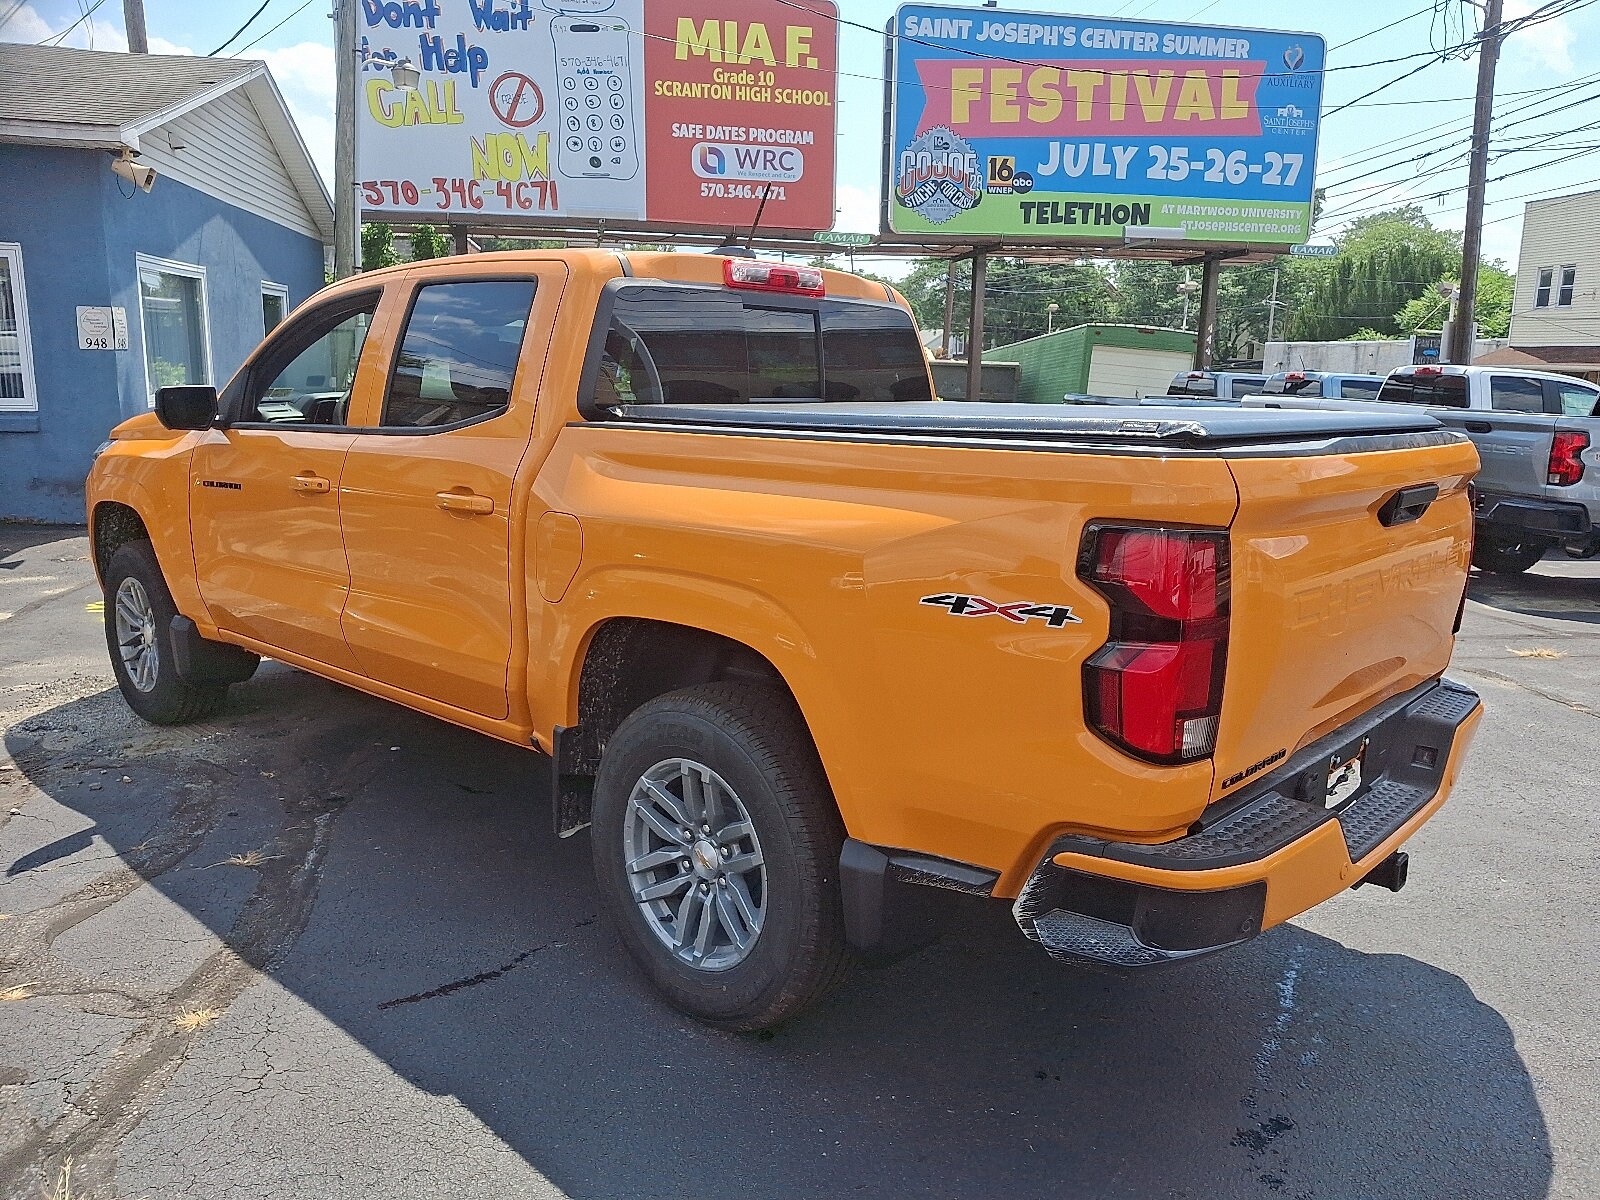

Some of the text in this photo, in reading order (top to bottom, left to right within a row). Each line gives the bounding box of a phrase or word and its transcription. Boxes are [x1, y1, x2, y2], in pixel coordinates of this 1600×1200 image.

[470, 0, 535, 32] Wait
[675, 17, 818, 69] MIA F.
[904, 16, 1250, 59] SAINT JOSEPH'S CENTER SUMMER
[361, 32, 488, 88] for Help
[560, 55, 627, 67] 570-346-4671
[713, 68, 775, 87] Grade 10
[1266, 77, 1315, 89] AUXILIARY
[366, 79, 464, 128] CALL
[654, 80, 832, 106] SCRANTON HIGH SCHOOL
[951, 66, 1249, 124] FESTIVAL
[1263, 115, 1286, 126] SAINT
[1271, 128, 1306, 136] CENTER
[672, 123, 814, 144] SAFE DATES PROGRAM
[471, 131, 550, 182] NOW
[735, 147, 796, 171] WRC
[1037, 141, 1304, 186] JULY 25-26-27
[989, 158, 1014, 182] 16
[1013, 178, 1032, 187] abc
[362, 178, 559, 210] 570-346-4671
[905, 180, 938, 208] STACHE
[941, 181, 957, 199] FOR
[952, 191, 974, 208] CASH
[1020, 201, 1150, 226] TELETHON
[1161, 204, 1303, 219] AT MARYWOOD UNIVERSITY
[818, 233, 865, 243] LAMAR
[1293, 246, 1335, 256] LAMAR
[86, 338, 107, 349] 948
[1221, 748, 1287, 789] COLORADO
